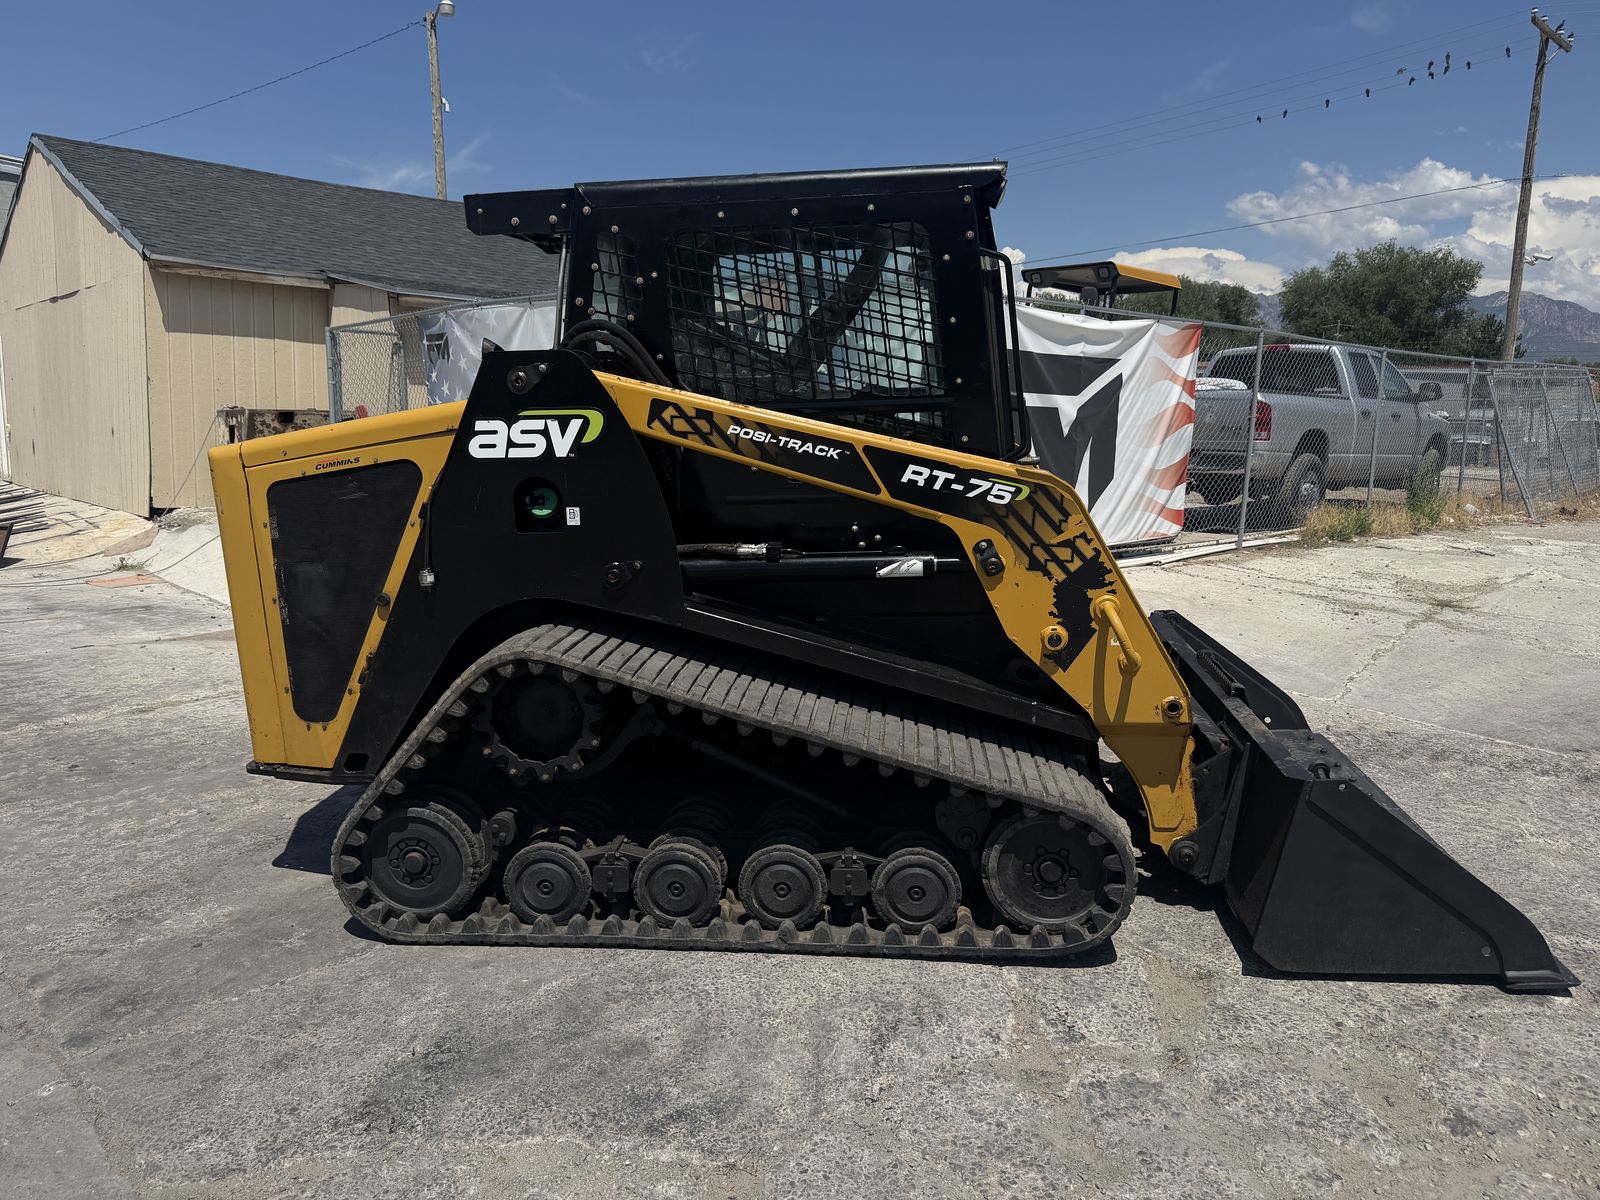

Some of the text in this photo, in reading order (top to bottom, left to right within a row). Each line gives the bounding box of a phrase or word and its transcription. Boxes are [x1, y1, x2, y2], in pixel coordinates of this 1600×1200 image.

[727, 425, 843, 460] POSI-TRACK
[315, 456, 360, 471] CUMMINS
[900, 464, 1017, 505] RT-75
